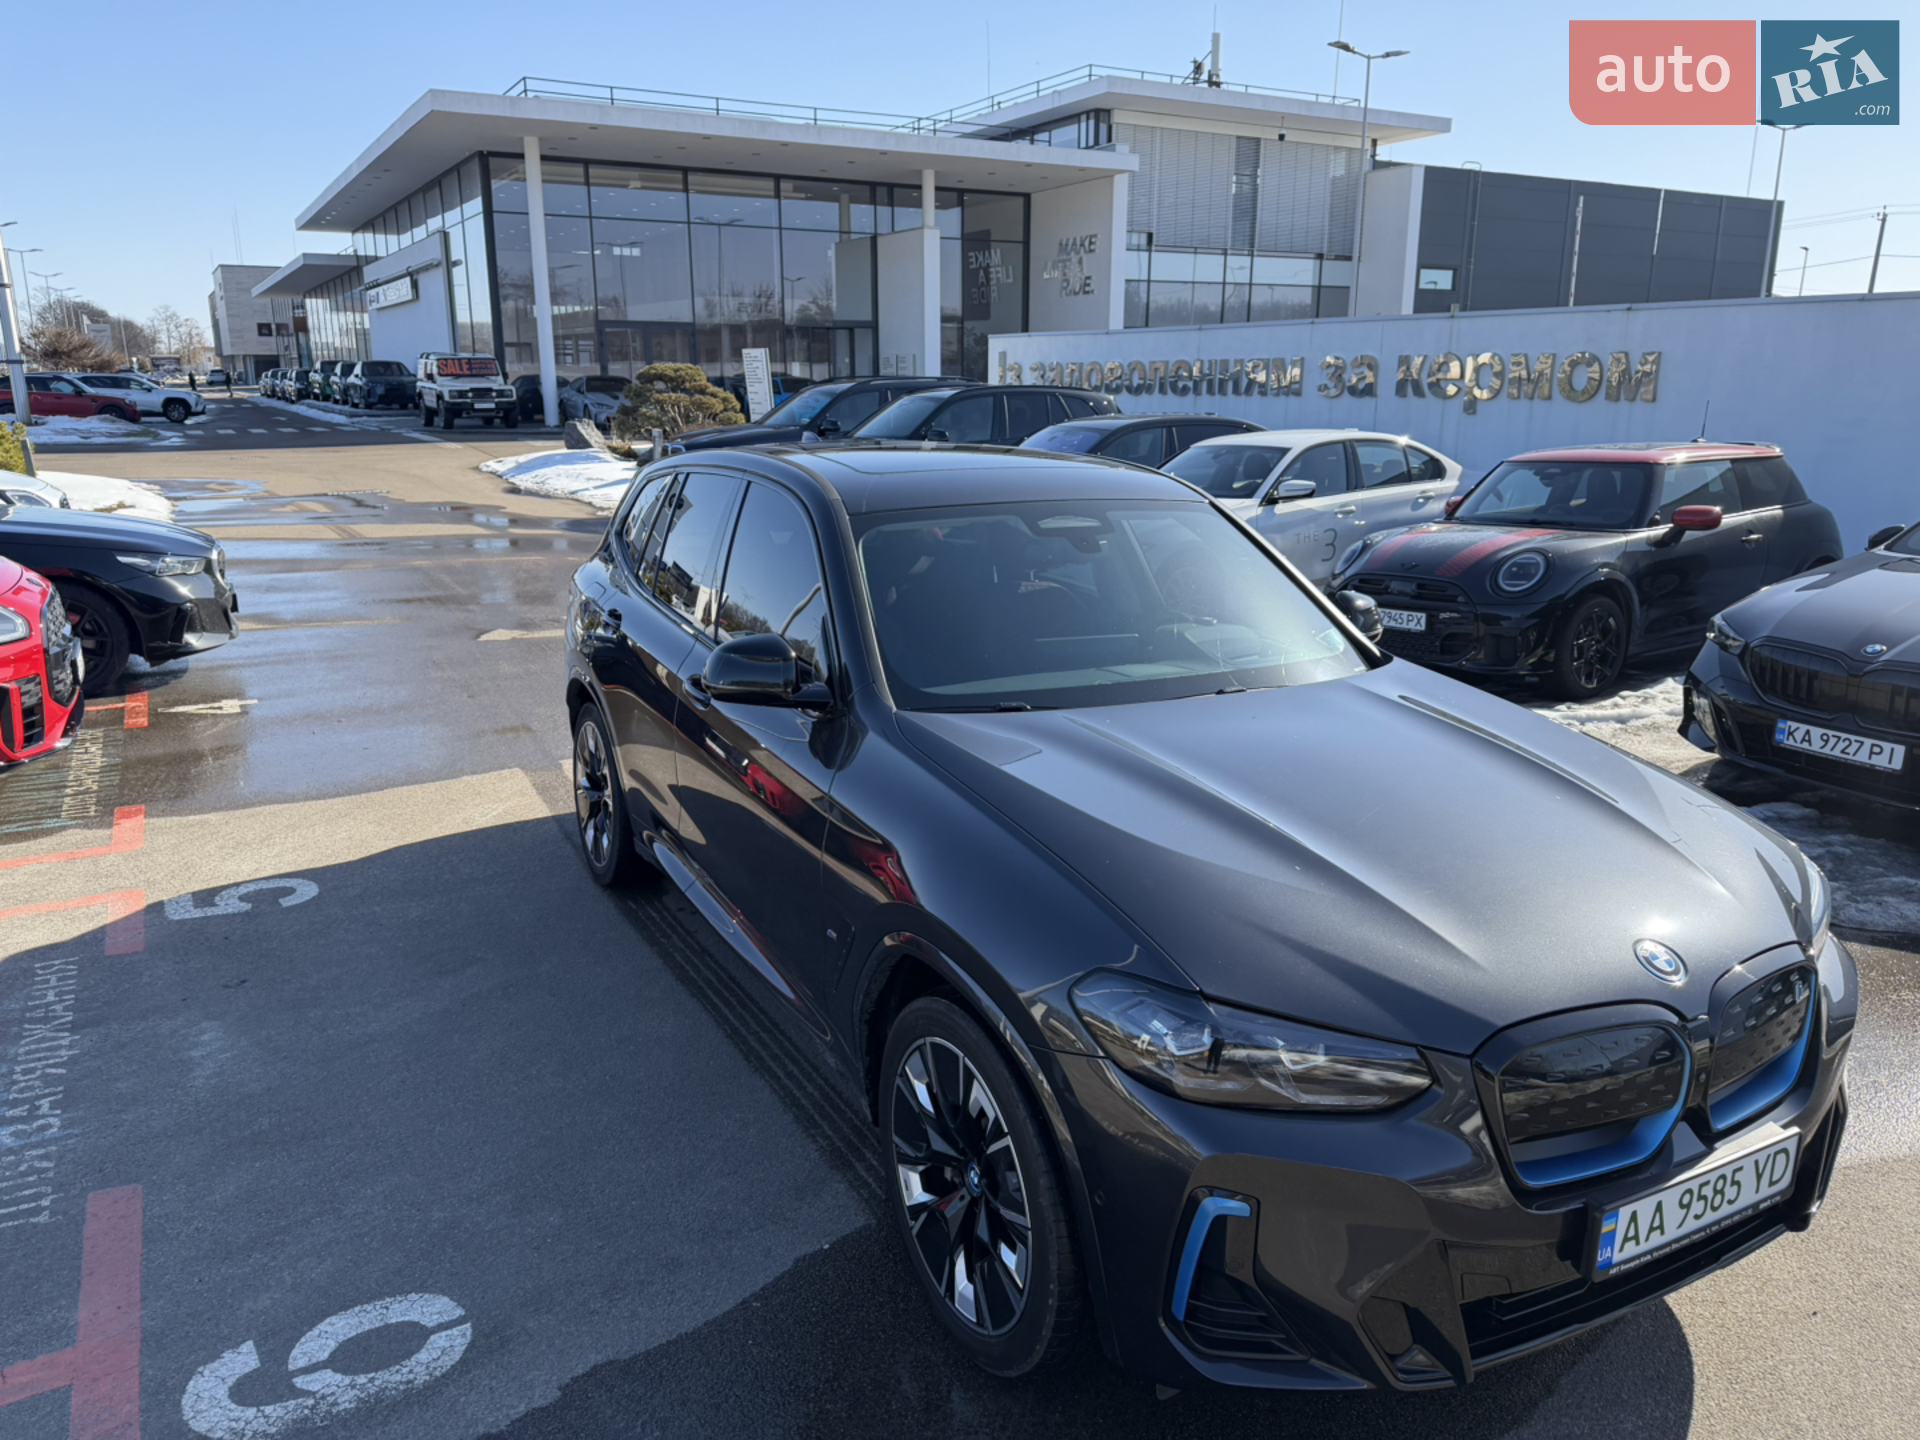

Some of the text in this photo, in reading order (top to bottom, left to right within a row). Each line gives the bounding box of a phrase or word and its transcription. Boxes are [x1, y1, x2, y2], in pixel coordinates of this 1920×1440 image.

[1058, 234, 1098, 257] MAKE
[1043, 256, 1086, 280] LIFE A
[1061, 276, 1095, 297] RIDE.
[438, 359, 470, 375] SALE
[1029, 357, 1305, 398] задоволенням
[1316, 352, 1379, 398] за
[1395, 350, 1662, 414] кермом
[1295, 528, 1338, 562] THE 3
[1406, 613, 1424, 628] PX
[1786, 725, 1812, 747] KA
[1819, 733, 1865, 757] 9727
[1868, 743, 1895, 765] PI
[163, 878, 320, 921] 5
[2, 956, 80, 1144] ЗАРЯДЖАННЯ
[1618, 1147, 1790, 1253] AA 9585 YD
[1597, 1246, 1612, 1262] UA
[181, 1292, 472, 1440] 6
